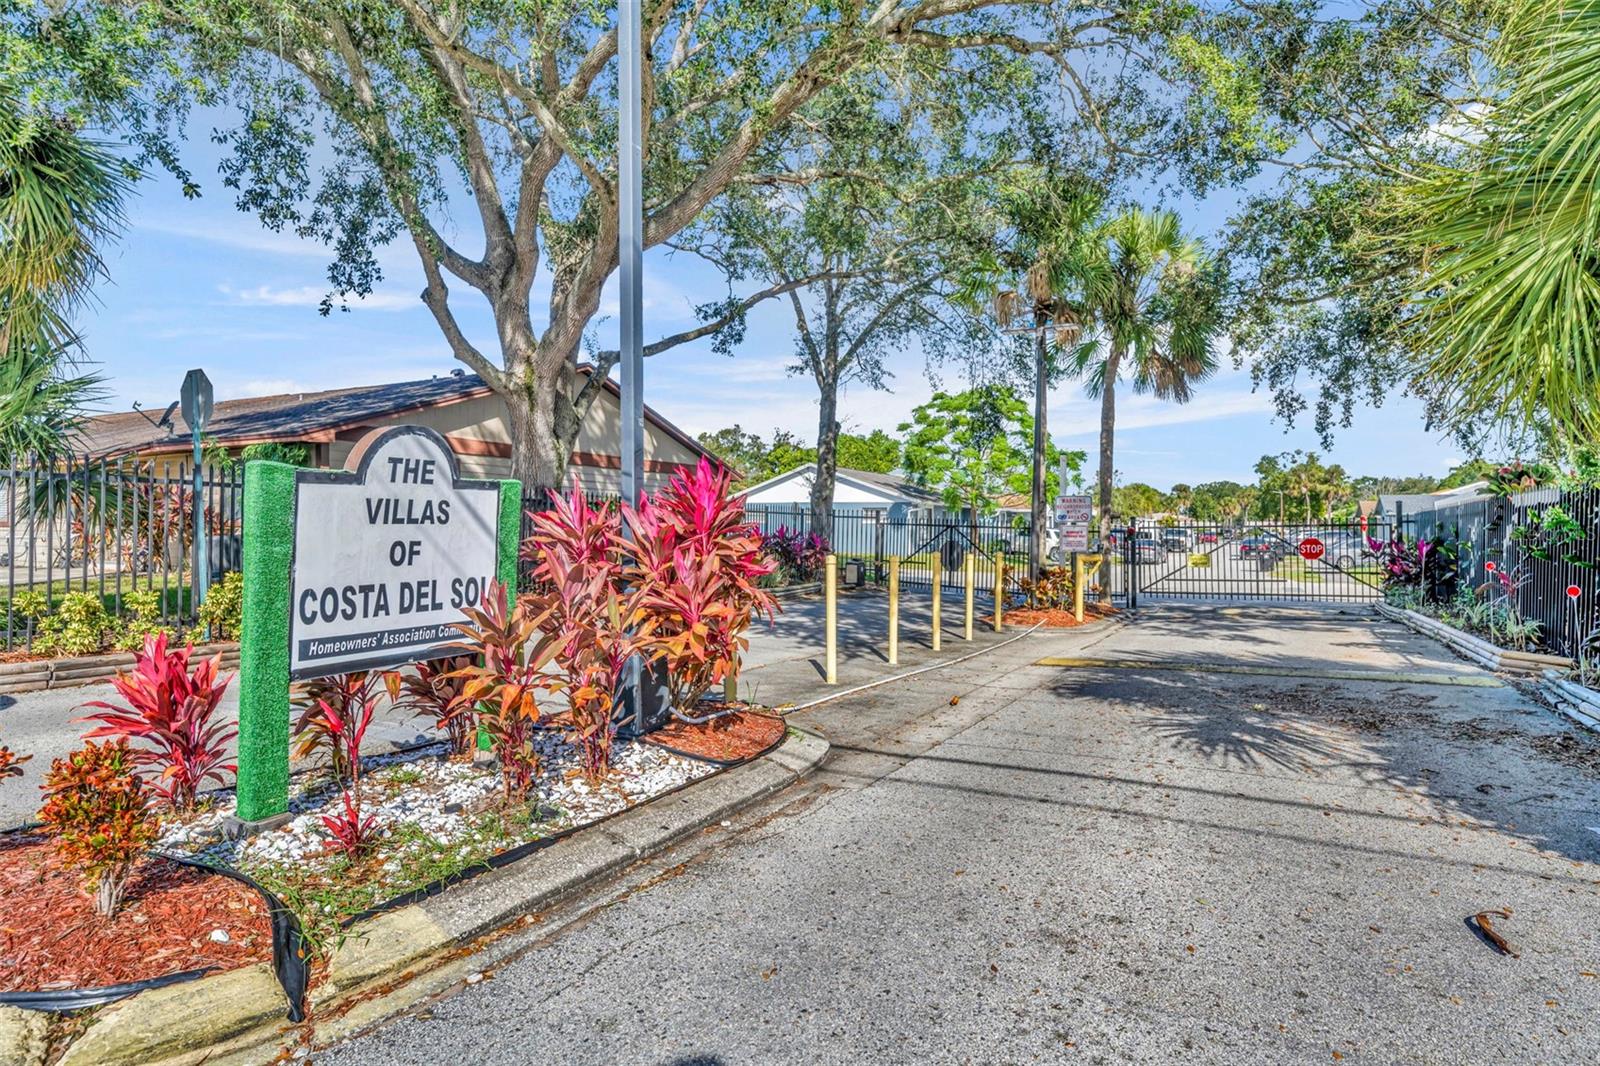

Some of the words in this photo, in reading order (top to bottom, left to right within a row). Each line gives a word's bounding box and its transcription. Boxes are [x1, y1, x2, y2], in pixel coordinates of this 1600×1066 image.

[388, 456, 436, 485] THE
[366, 498, 451, 525] VILLAS
[389, 540, 422, 567] OF
[1300, 544, 1323, 554] STOP
[299, 583, 391, 626] COSTA
[398, 579, 444, 615] DEL
[308, 633, 382, 657] Homeowners'
[382, 627, 436, 646] Association
[438, 624, 482, 638] Commit
